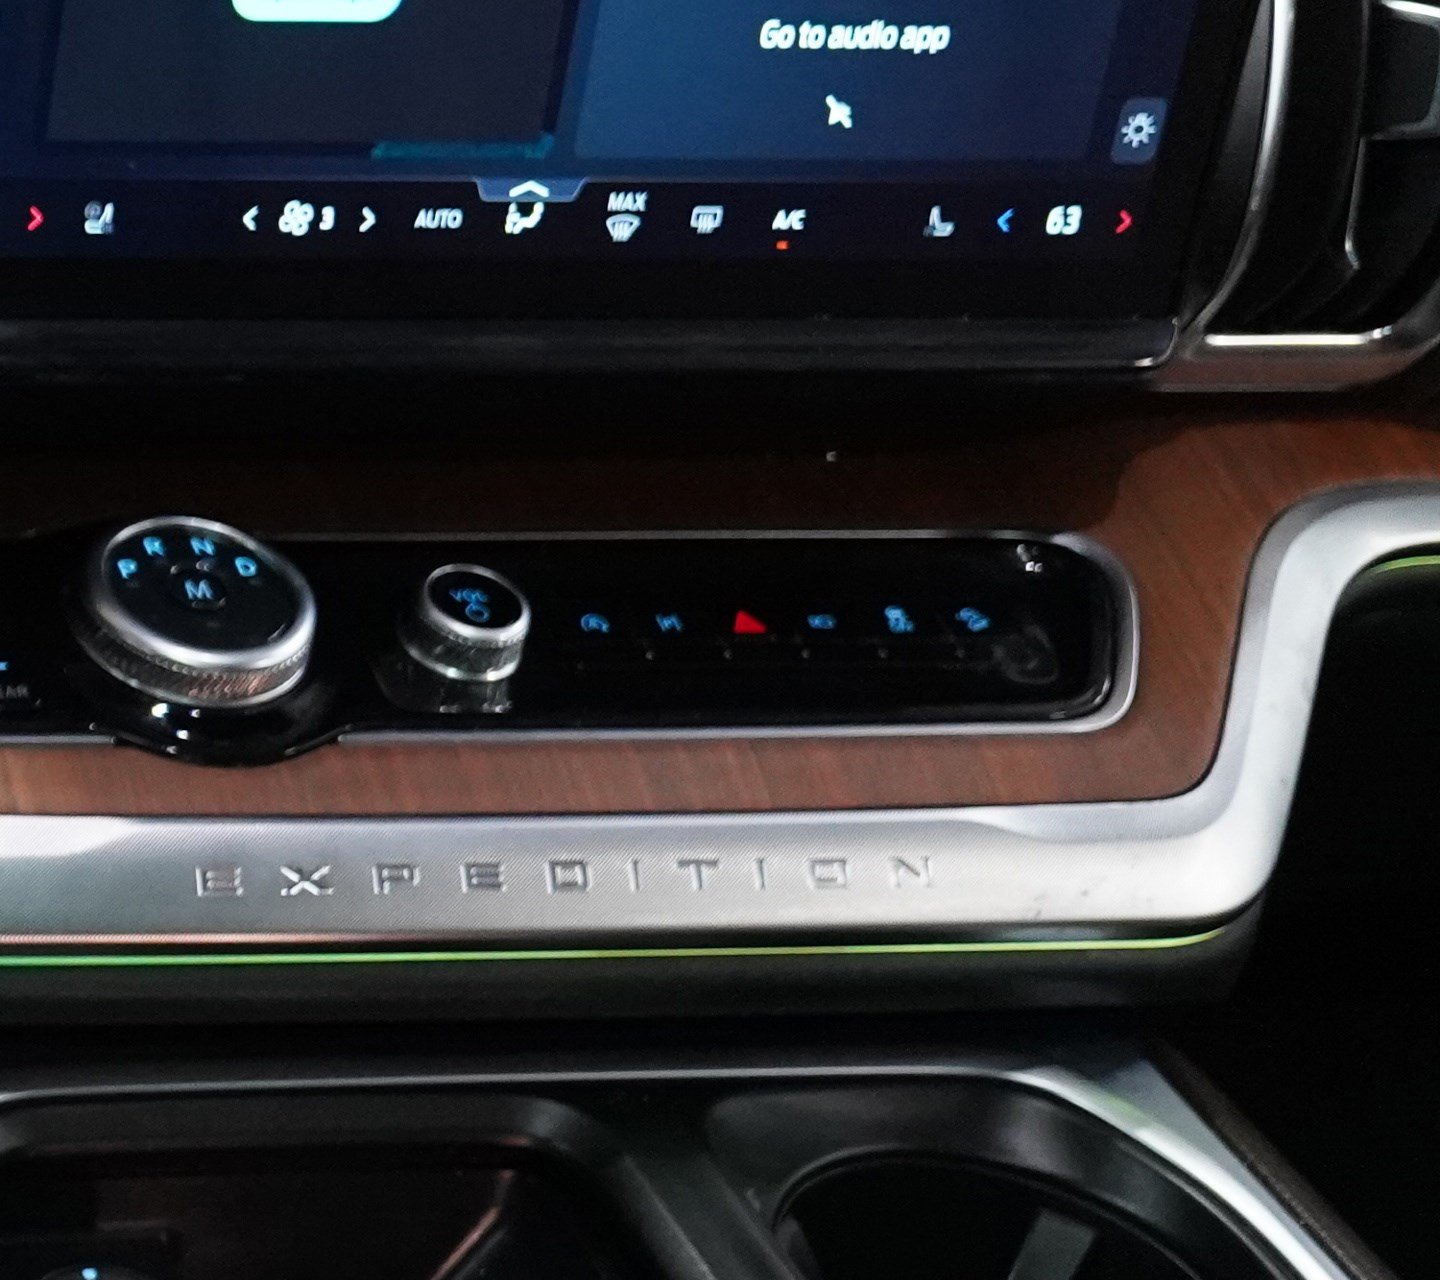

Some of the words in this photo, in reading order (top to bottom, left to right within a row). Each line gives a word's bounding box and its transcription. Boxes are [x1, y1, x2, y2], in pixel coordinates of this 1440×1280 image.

[759, 18, 796, 50] Go
[798, 20, 827, 50] to
[827, 18, 899, 50] audio
[899, 24, 951, 55] app
[607, 191, 647, 213] MAX
[318, 205, 335, 231] 3
[413, 208, 463, 230] AUTO
[771, 208, 807, 231] A/C
[1045, 206, 1082, 236] 63
[143, 535, 166, 557] R
[190, 535, 216, 556] N
[116, 558, 139, 580] P
[234, 556, 258, 578] D
[184, 578, 214, 601] M
[195, 854, 935, 898] EXPEDITION
